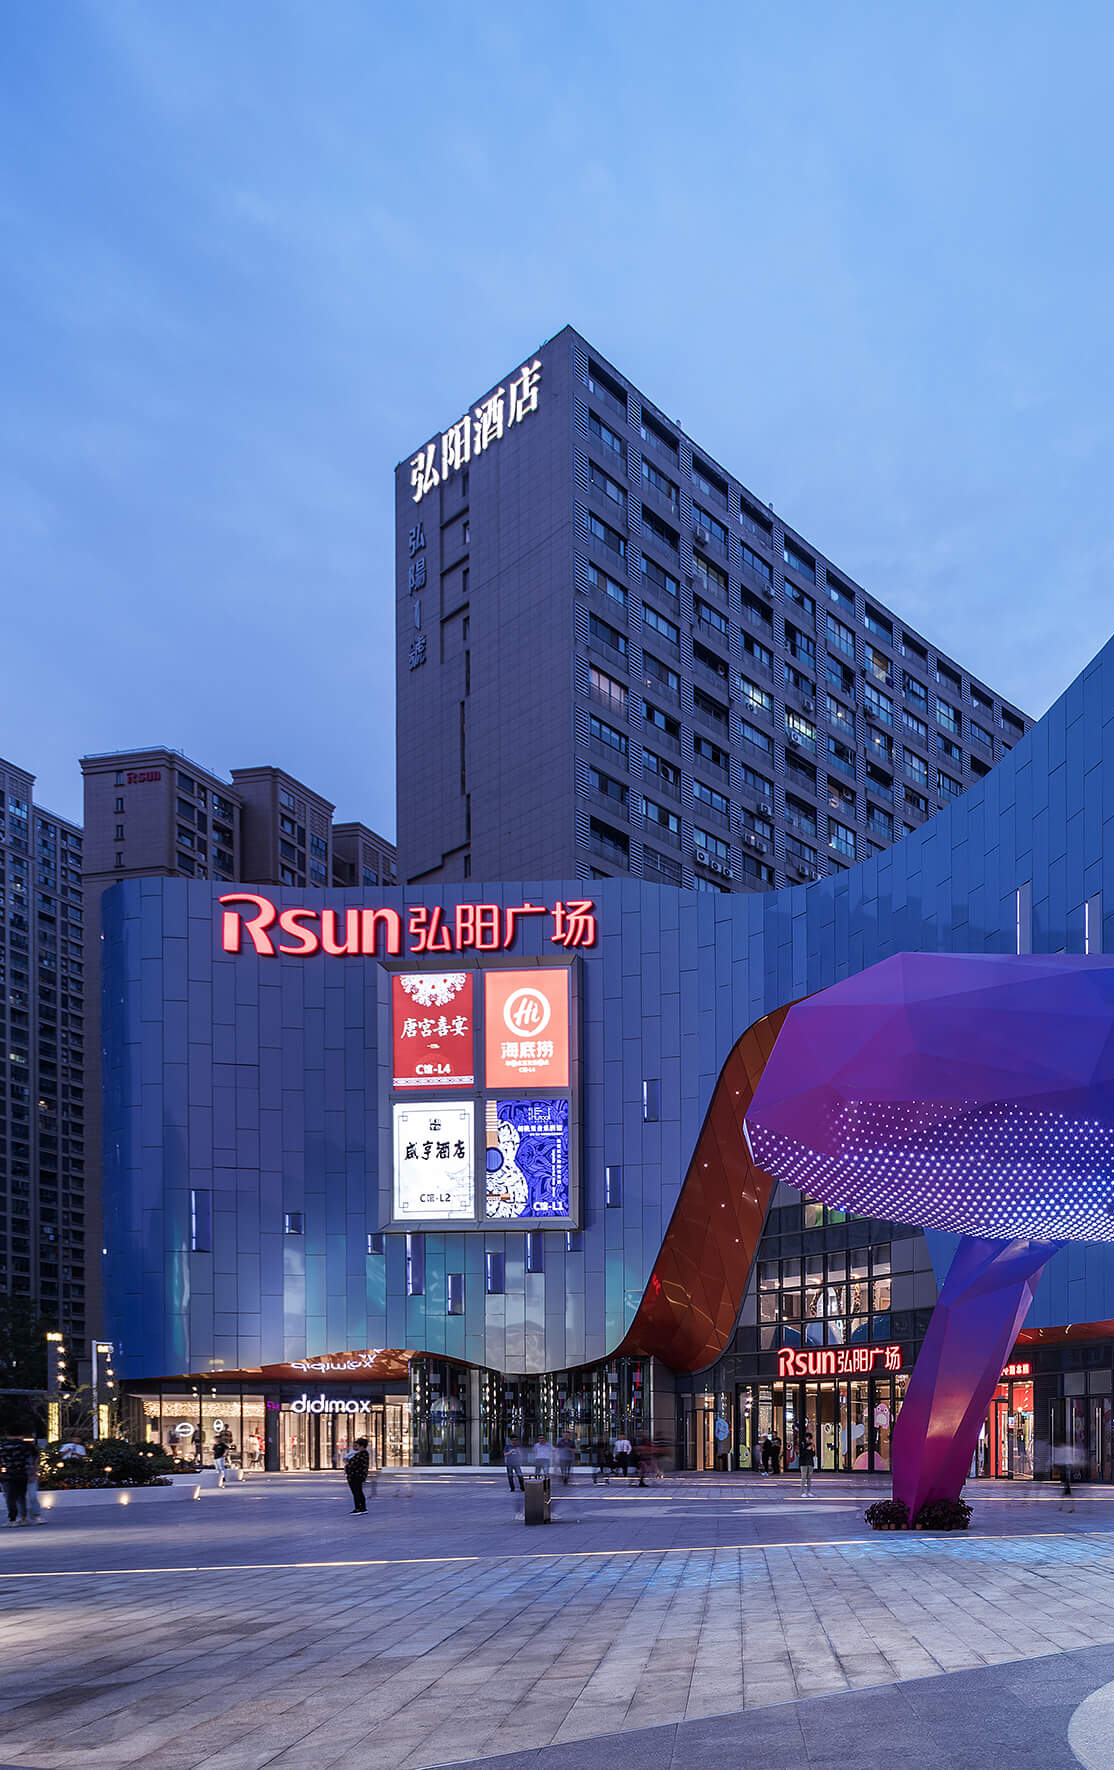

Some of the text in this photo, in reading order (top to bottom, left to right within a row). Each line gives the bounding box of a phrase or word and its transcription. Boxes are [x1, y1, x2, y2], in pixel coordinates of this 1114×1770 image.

[410, 360, 542, 503] 弘阳酒店
[219, 893, 596, 955] Rsun 弘阳广场
[777, 1345, 902, 1377] Rsun 弘阳广场
[291, 1393, 371, 1413] didimax
